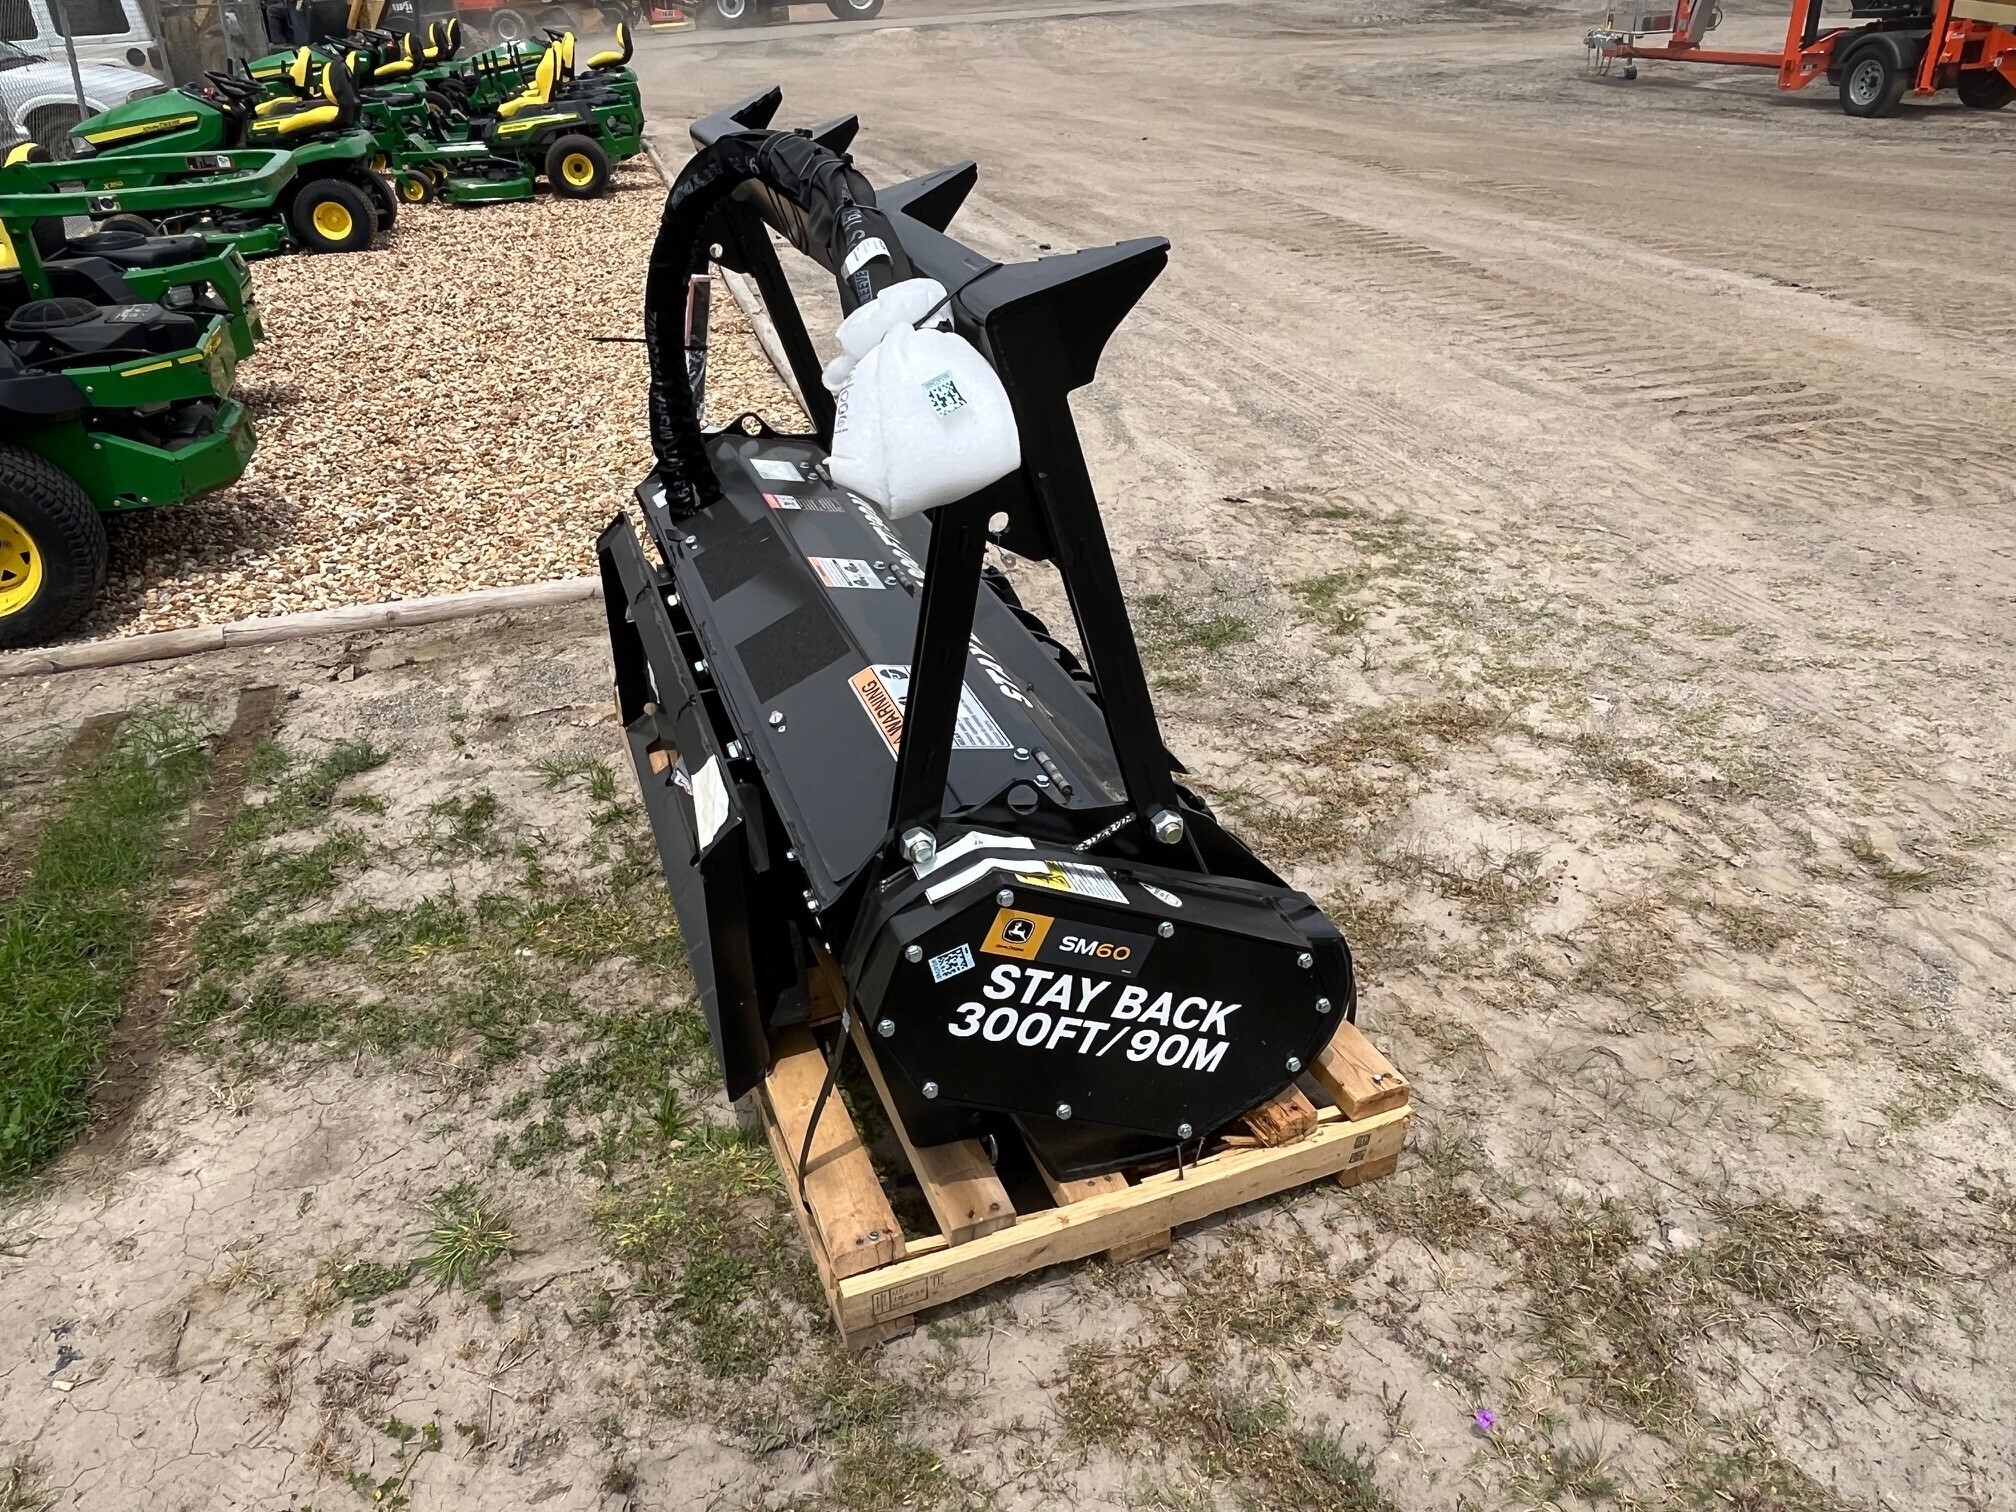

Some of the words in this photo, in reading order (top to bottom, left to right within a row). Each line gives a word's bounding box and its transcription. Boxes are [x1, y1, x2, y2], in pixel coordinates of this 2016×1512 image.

[862, 680, 903, 737] WARNING
[1058, 936, 1131, 961] SM60
[982, 964, 1111, 1013] STAY
[1111, 985, 1242, 1035] BACK
[948, 1002, 1230, 1072] 300FT/90M
